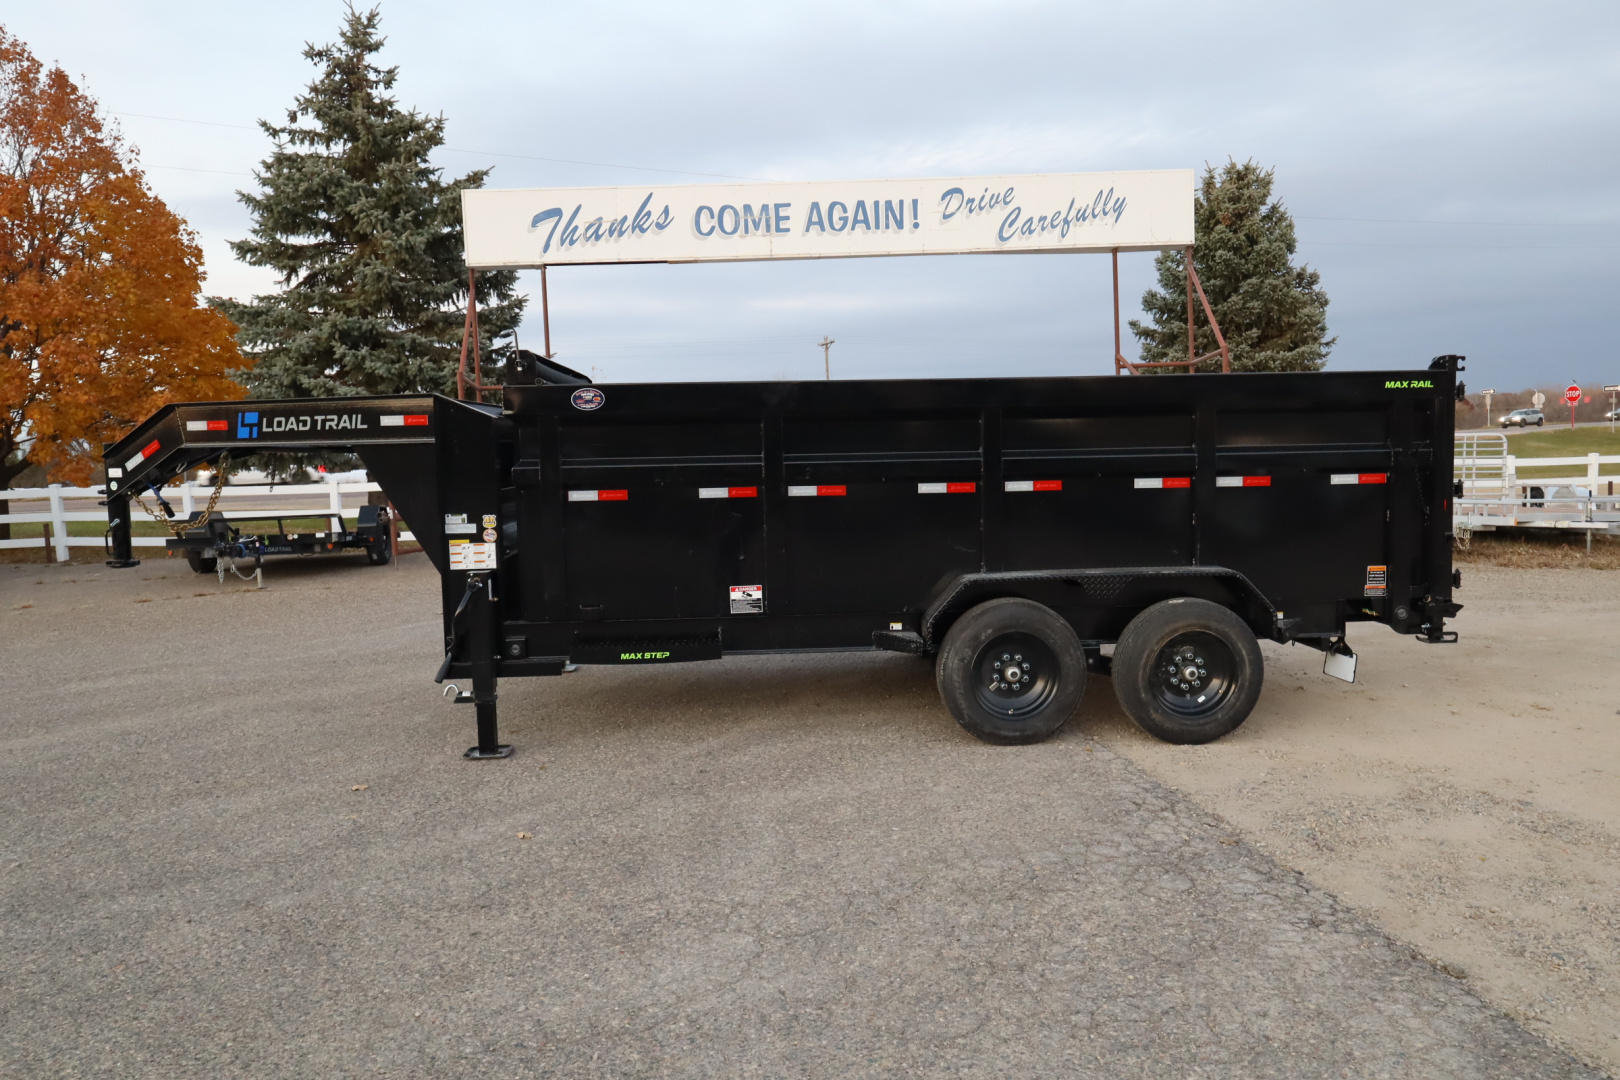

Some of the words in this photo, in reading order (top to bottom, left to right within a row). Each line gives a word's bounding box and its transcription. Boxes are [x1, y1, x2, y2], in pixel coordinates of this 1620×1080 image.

[940, 186, 1015, 220] Drive
[531, 191, 675, 254] Thanks
[694, 202, 792, 237] COME
[805, 198, 920, 233] AGAIN!
[998, 187, 1128, 243] Carefully
[1384, 380, 1409, 389] MAX
[1410, 380, 1434, 388] RAIL
[1566, 390, 1580, 398] STOP
[262, 416, 311, 432] LOAD
[314, 414, 368, 430] TRAIL
[620, 652, 643, 660] MAX
[644, 651, 670, 659] STEP
